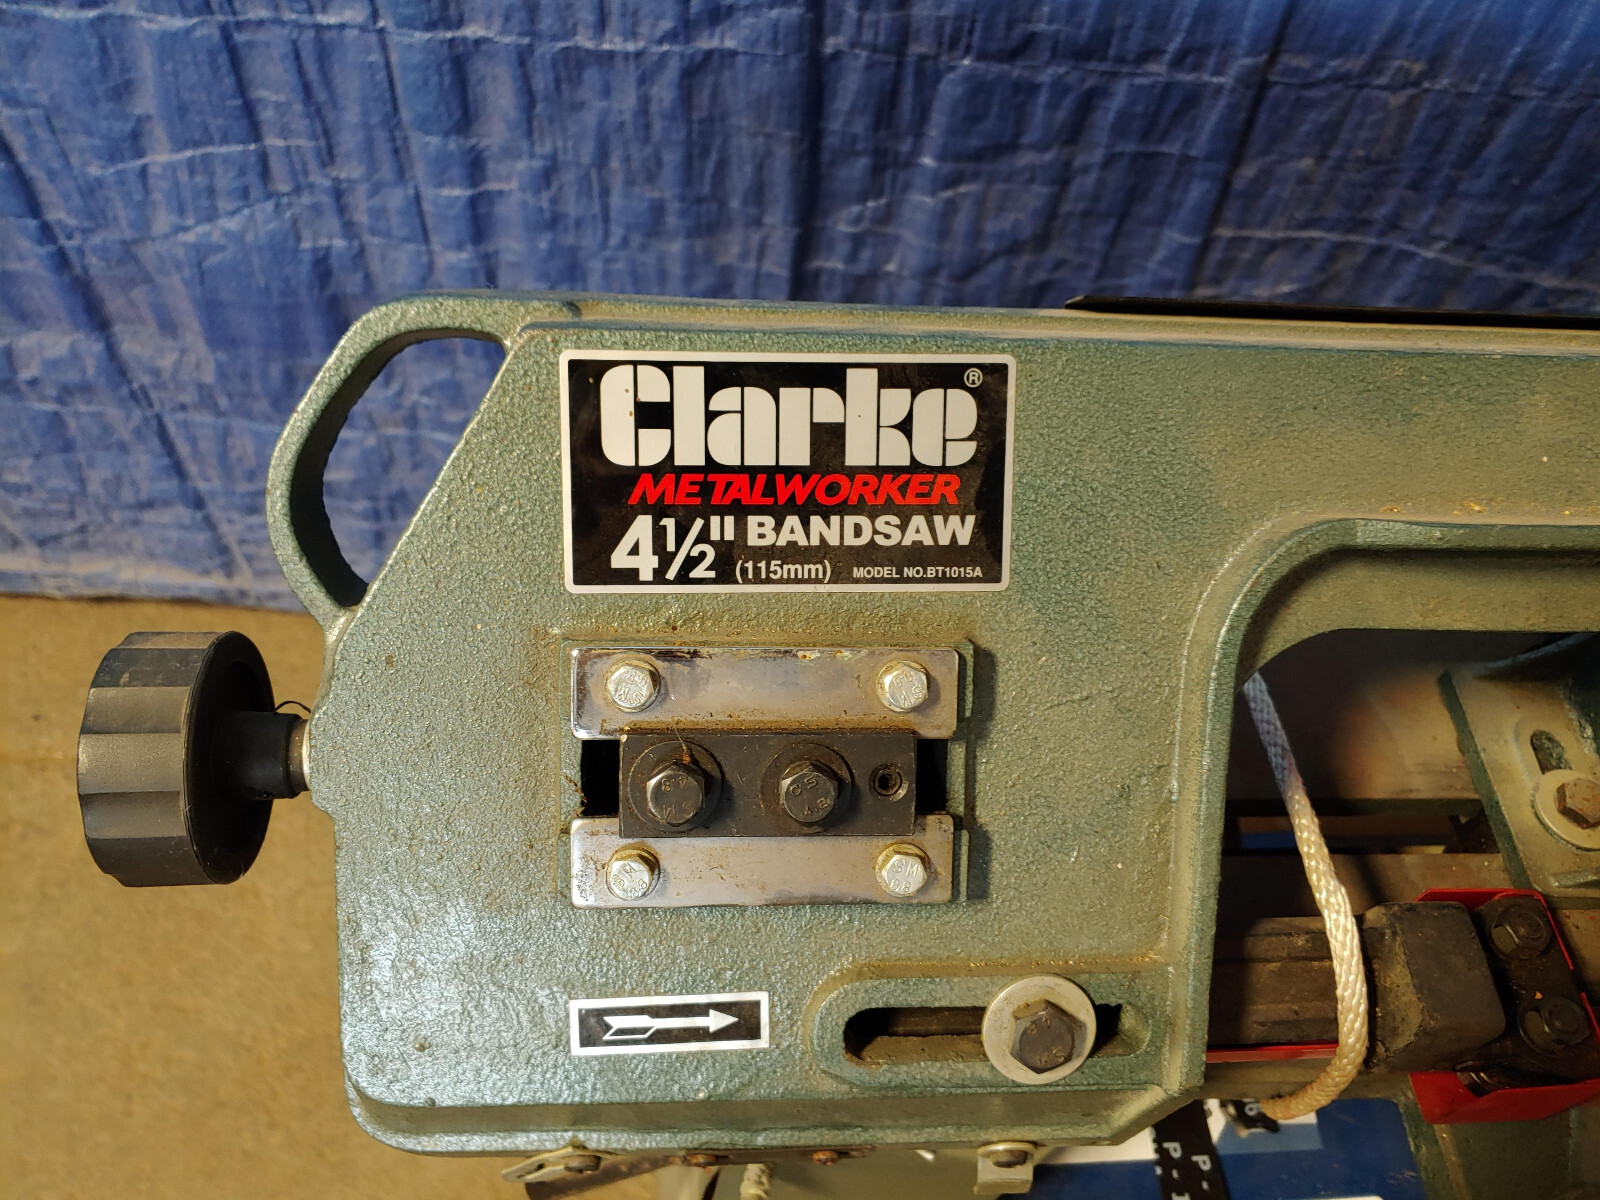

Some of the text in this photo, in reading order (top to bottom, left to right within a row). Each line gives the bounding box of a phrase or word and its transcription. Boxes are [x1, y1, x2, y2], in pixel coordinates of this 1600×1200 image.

[600, 364, 978, 467] Clarke
[628, 473, 962, 505] METALWORKER
[747, 514, 977, 547] BANDSAW
[735, 559, 983, 584] (115mm) MODEL NO.BT1015A
